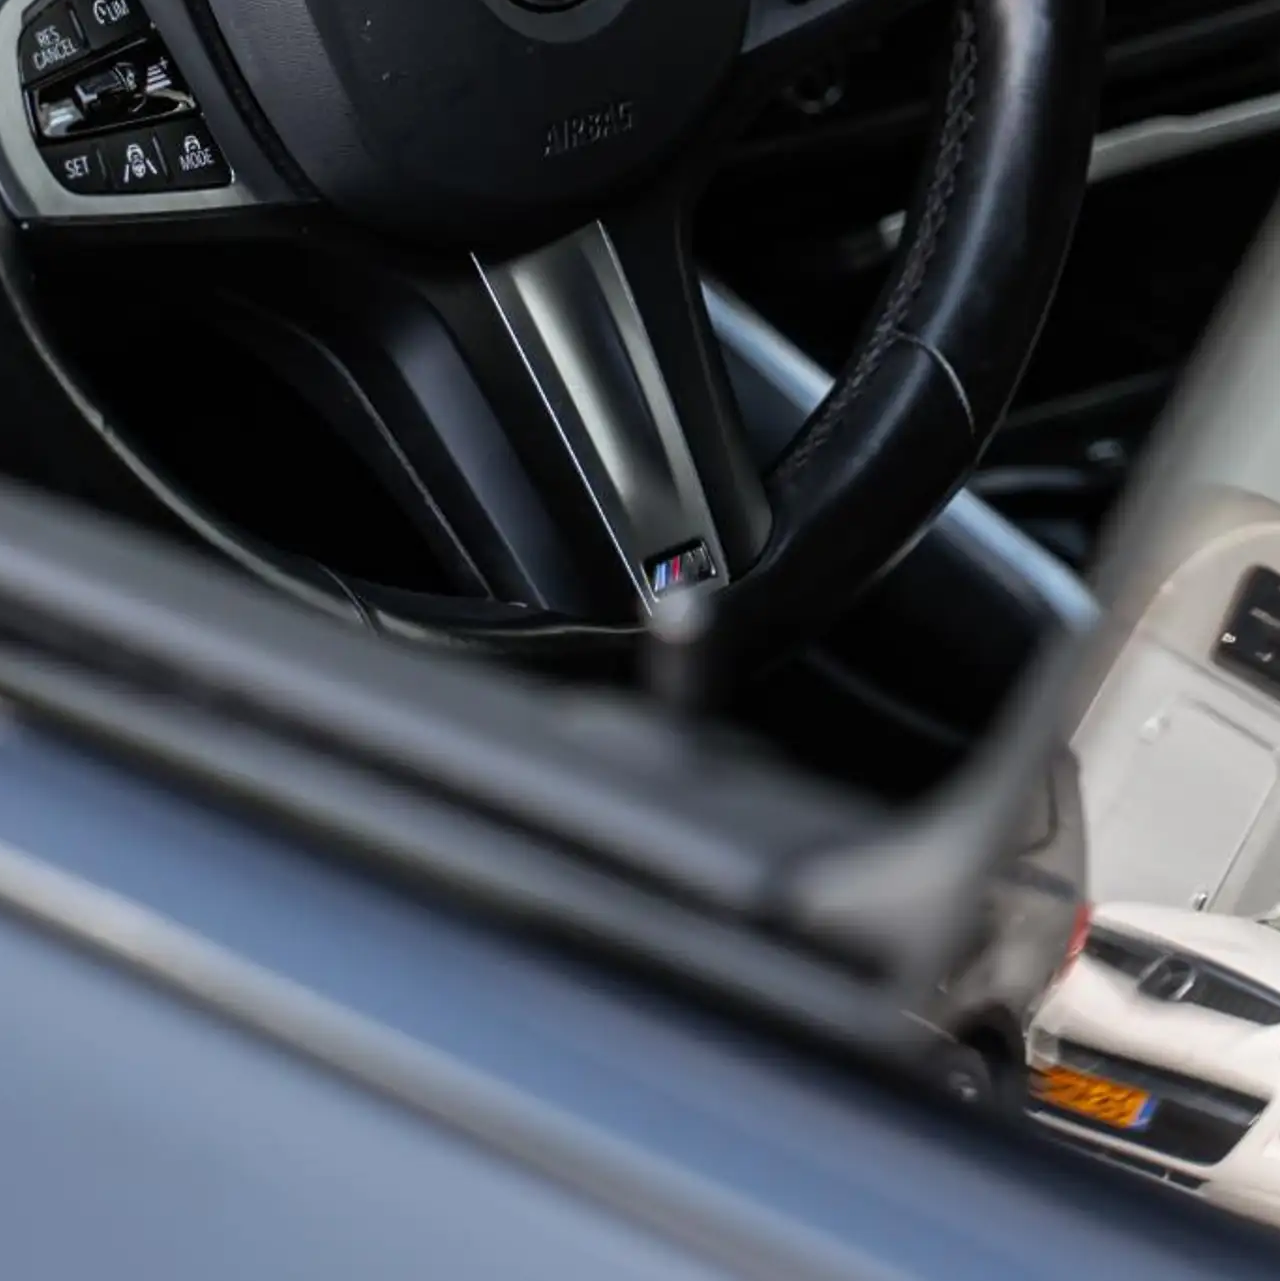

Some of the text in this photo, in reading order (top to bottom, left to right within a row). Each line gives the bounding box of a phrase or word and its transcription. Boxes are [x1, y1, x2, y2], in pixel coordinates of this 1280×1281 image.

[35, 25, 60, 48] RES
[33, 38, 77, 71] CANCEL
[541, 102, 633, 161] AIRBAG
[64, 156, 89, 180] SET
[179, 148, 214, 172] MODE
